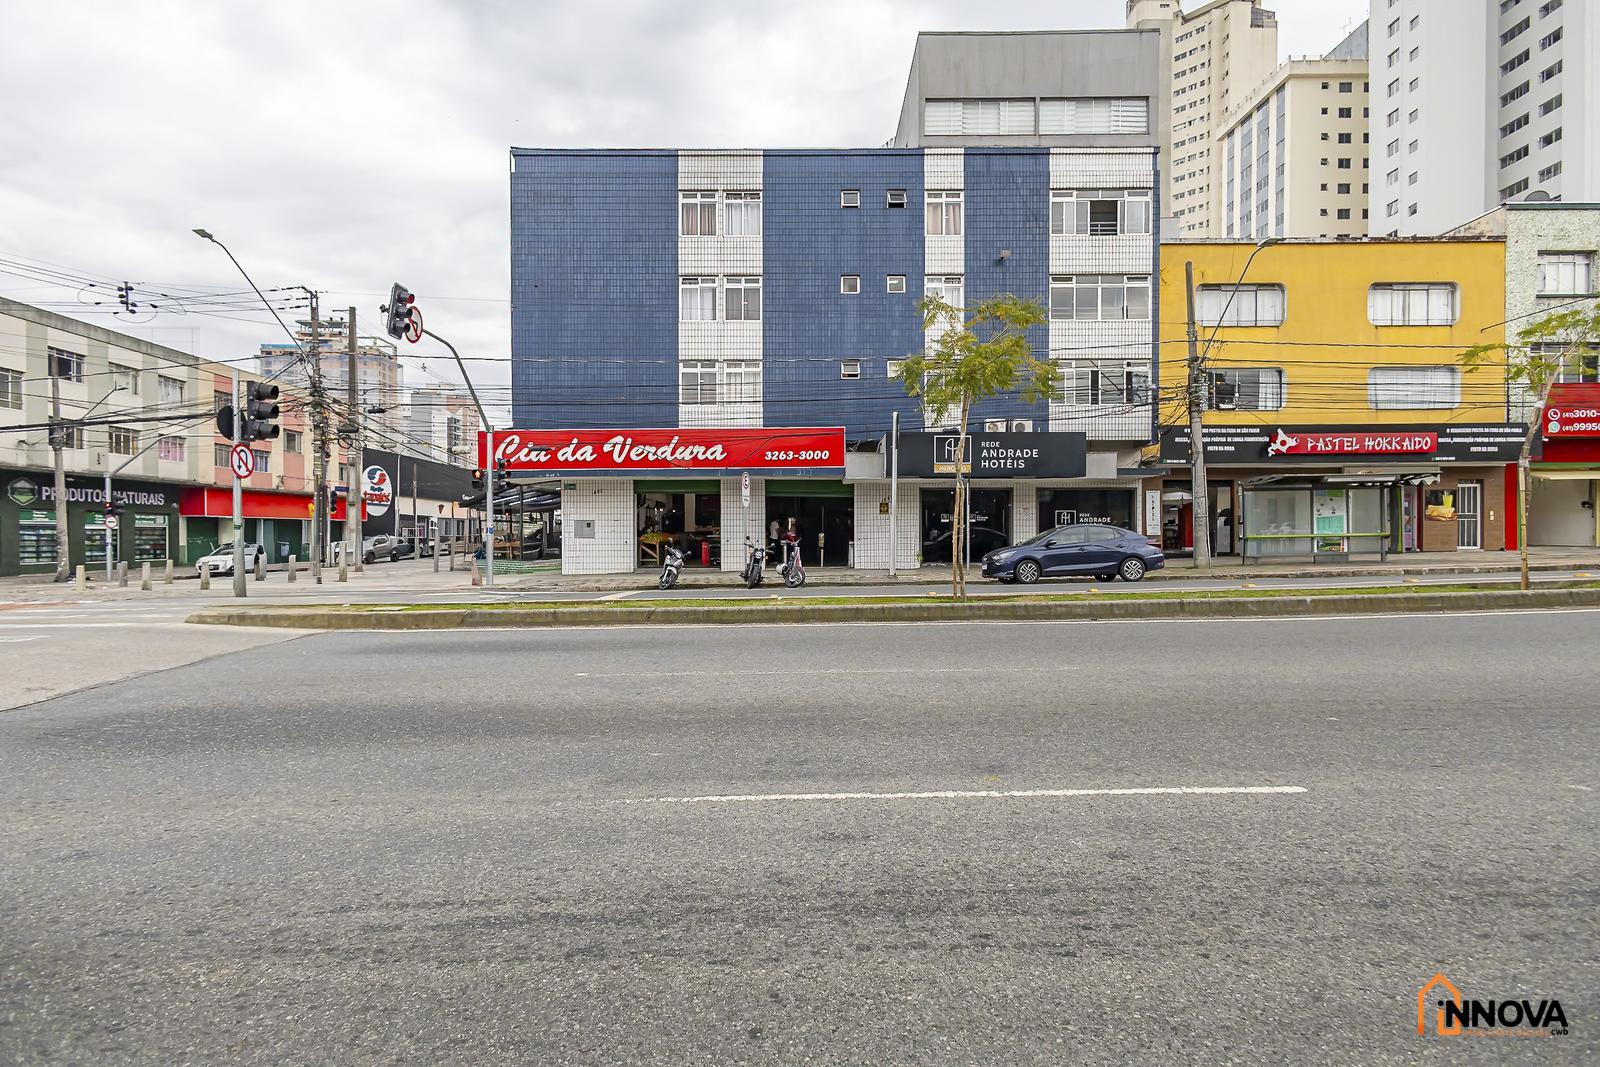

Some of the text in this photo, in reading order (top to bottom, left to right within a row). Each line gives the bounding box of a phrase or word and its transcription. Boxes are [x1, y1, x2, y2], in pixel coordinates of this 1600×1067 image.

[557, 437, 597, 462] da
[603, 435, 727, 463] Verdura
[1307, 437, 1360, 451] PASTEL
[1364, 436, 1431, 450] HOKKAIDO
[765, 450, 830, 461] 3263-3000
[981, 449, 1039, 458] ANDRADE
[981, 458, 1025, 468] HOTÉIS
